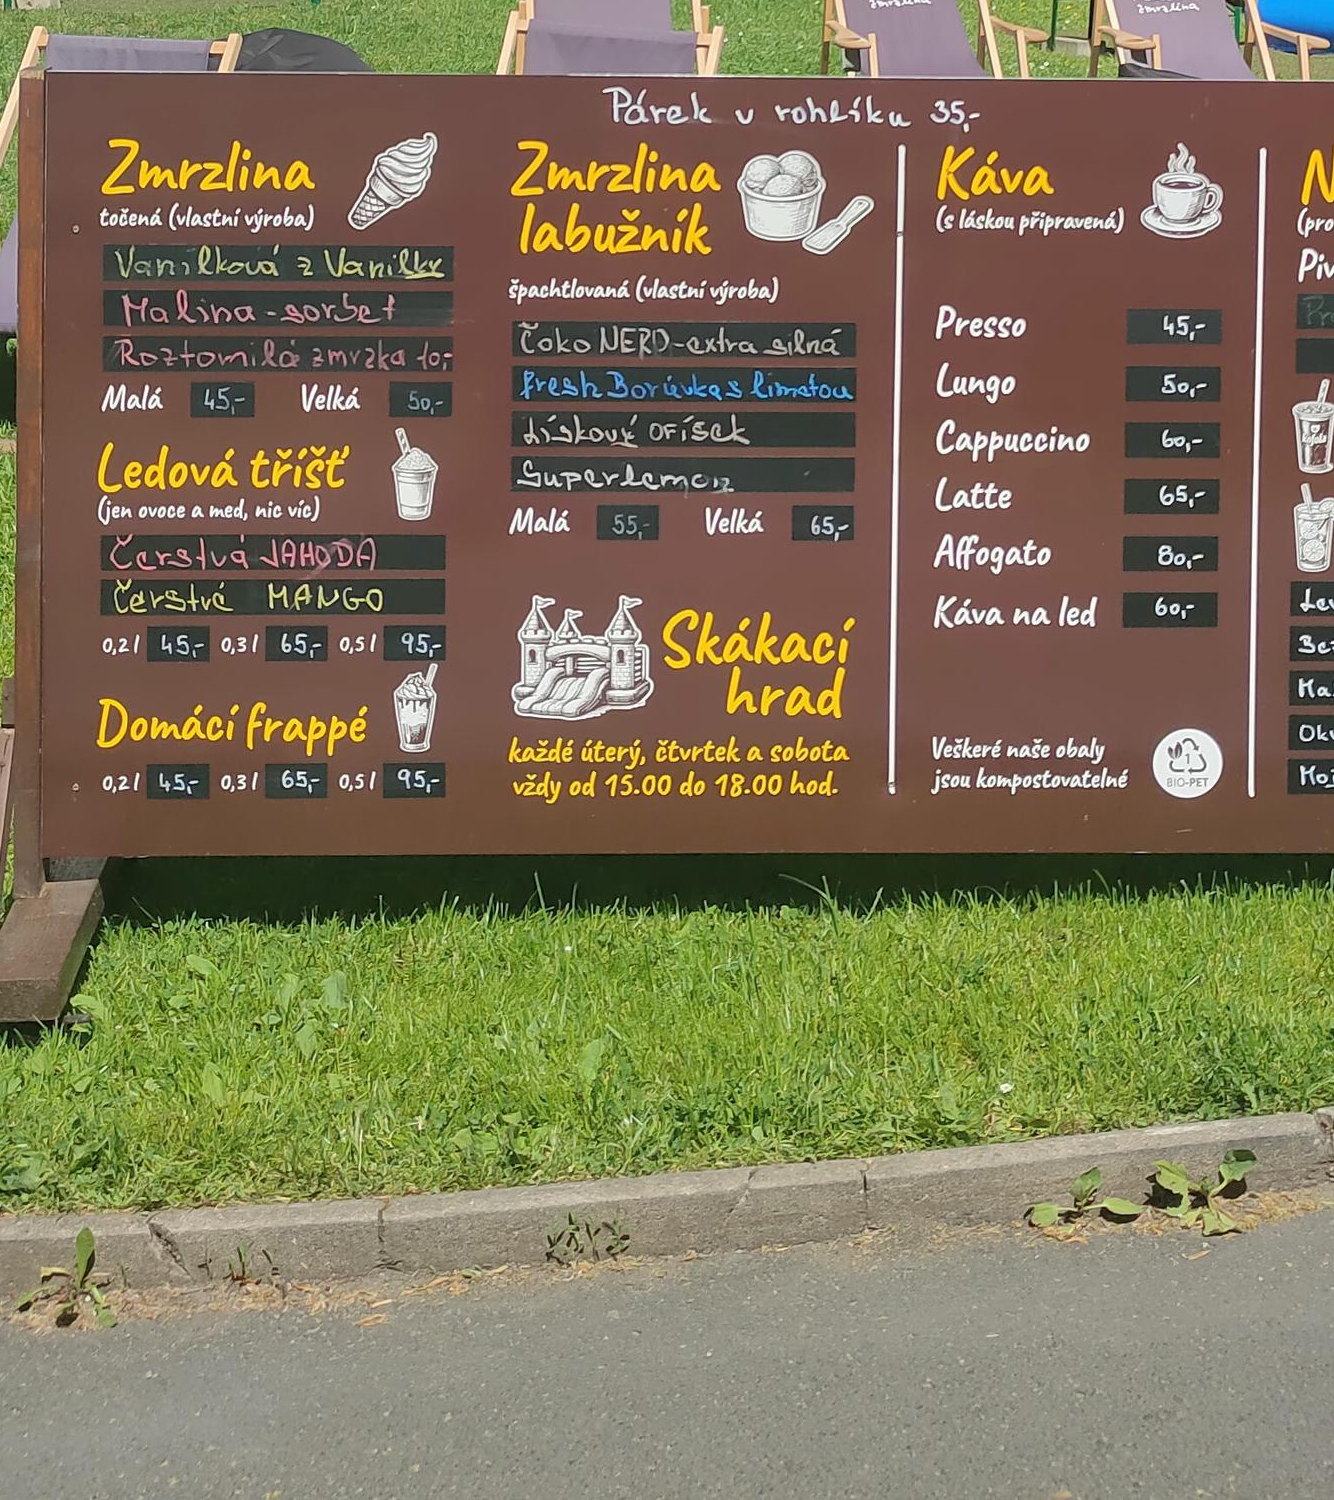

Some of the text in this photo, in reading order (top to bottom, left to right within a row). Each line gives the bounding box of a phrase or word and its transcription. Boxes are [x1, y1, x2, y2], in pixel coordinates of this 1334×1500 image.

[602, 87, 980, 133] Párek v rohlíku 35,-
[102, 139, 315, 195] Zmrzlina
[511, 141, 721, 196] Zmrzlina
[937, 145, 1054, 200] Káva
[100, 202, 314, 233] točená (vlastní výroba)
[520, 202, 712, 255] labužník
[936, 205, 1124, 236] (s láskou připravená)
[1298, 208, 1334, 238] (pro
[115, 244, 279, 277] Vanilková
[298, 257, 313, 275] z
[509, 275, 778, 305] špachtlovaná (vlastní výroba)
[519, 322, 590, 353] Čoko
[764, 329, 841, 355] silná
[936, 305, 1026, 339] Presso
[1164, 316, 1205, 340] 45,-
[102, 384, 163, 412] Malá
[205, 388, 244, 414] 45,-
[302, 384, 360, 412] Velká
[937, 362, 1016, 404] Lungo
[1162, 374, 1206, 397] 50,-
[936, 419, 1090, 462] Cappuccino
[1162, 430, 1202, 452] 60,-
[98, 442, 349, 493] Ledová tříšť
[98, 495, 320, 525] (jen ovoce a med, nic víc)
[935, 477, 1012, 511] Latte
[1160, 485, 1205, 507] 65,-
[509, 507, 570, 534] Malá
[706, 507, 764, 535] Velká
[812, 516, 848, 541] 65,-
[110, 534, 248, 570] Čerstvá
[933, 534, 1051, 574] Affogato
[1158, 545, 1203, 569] 80,-
[269, 583, 382, 611] MANGO
[934, 595, 1098, 628] Káva na led
[1155, 597, 1194, 619] 60,-
[162, 635, 204, 657] 45,-
[282, 634, 321, 658] 65,-
[402, 633, 441, 657] 95,-
[663, 609, 855, 672] Skákací
[727, 666, 846, 718] hrad
[96, 698, 368, 756] Domácí frappé
[508, 736, 850, 770] každé úterý, čtvrtek a sobota
[933, 736, 1105, 764] Veškeré naše obaly
[160, 773, 198, 794] 45,-
[282, 770, 319, 793] 65,-
[398, 769, 439, 793] 95,-
[513, 770, 838, 804] vždy od 15.00 do 18.00 hod.
[931, 767, 1128, 794] jsou kompostovatelné
[1166, 776, 1209, 788] BIO-PET
